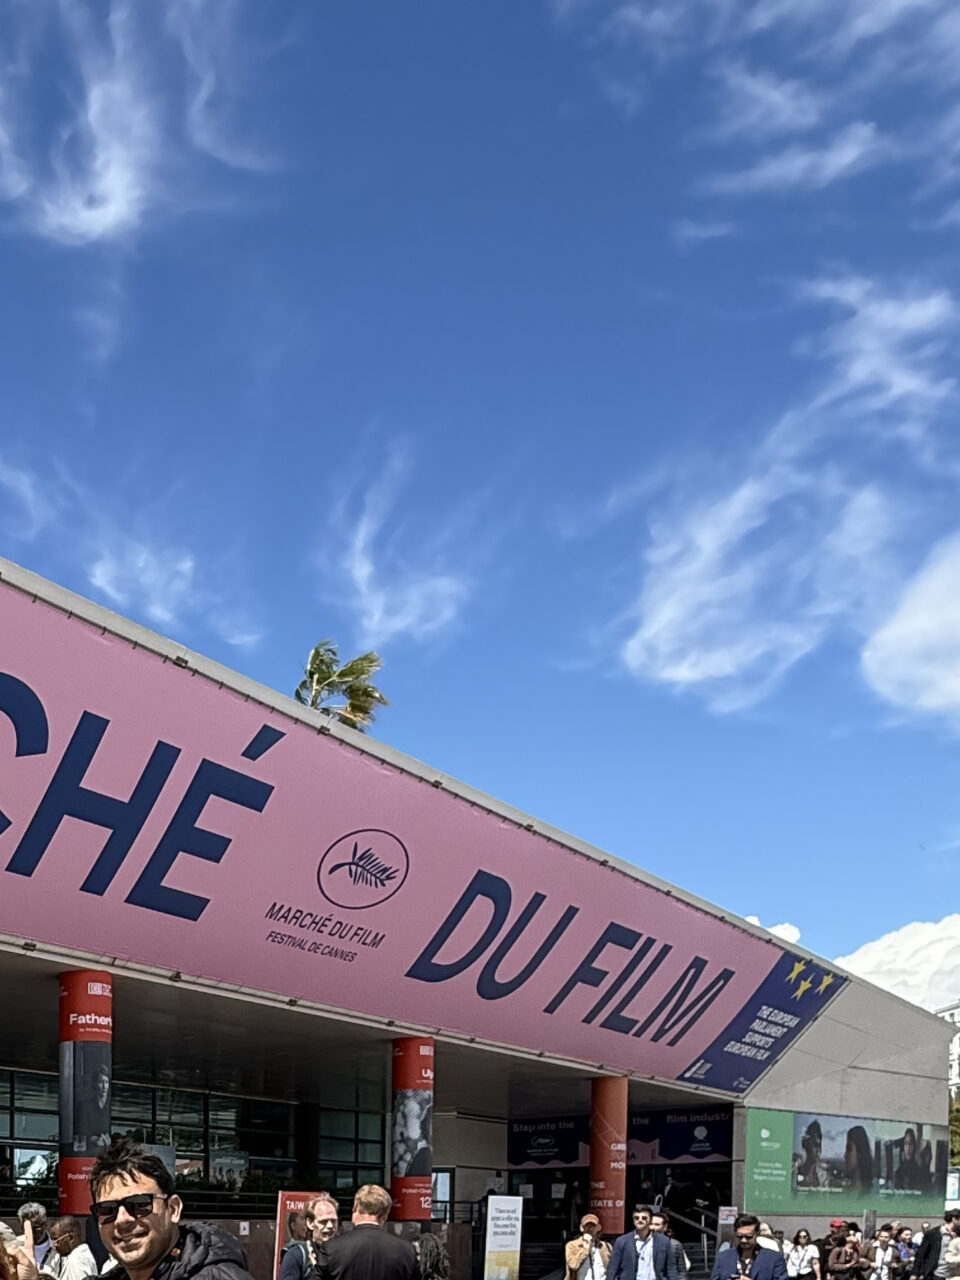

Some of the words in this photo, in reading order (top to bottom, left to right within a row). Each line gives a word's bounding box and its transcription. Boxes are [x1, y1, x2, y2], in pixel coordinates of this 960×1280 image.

[265, 902, 334, 934] MARCHÉ
[328, 921, 353, 939] DU
[349, 927, 386, 949] FILM
[265, 931, 308, 951] FESTIVAL
[307, 942, 322, 954] DE
[320, 945, 358, 962] CANNES
[405, 869, 579, 1000] DU
[543, 921, 736, 1047] FILM
[513, 1122, 536, 1133] Step
[537, 1121, 557, 1131] into
[666, 1113, 688, 1124] film
